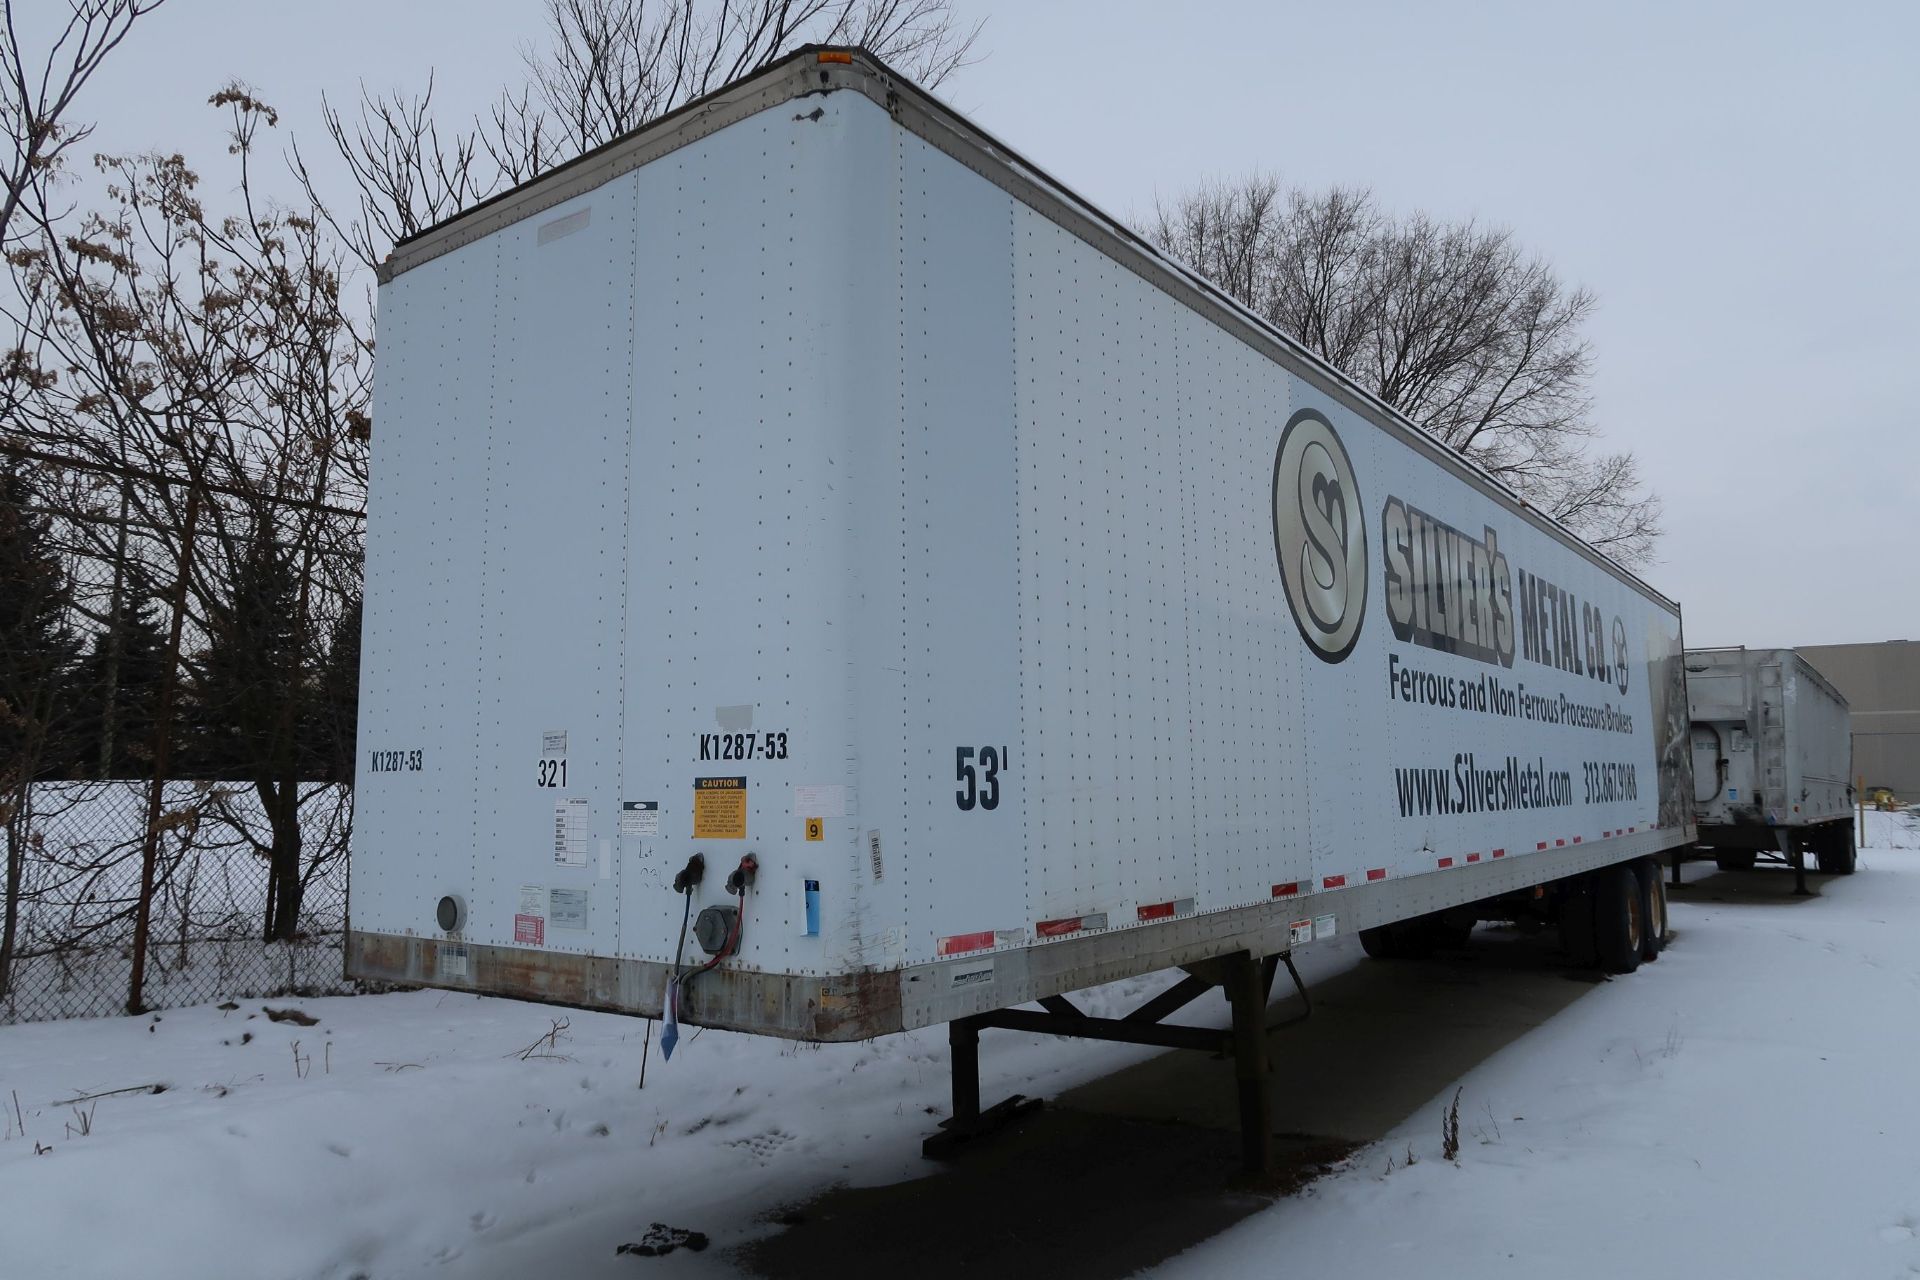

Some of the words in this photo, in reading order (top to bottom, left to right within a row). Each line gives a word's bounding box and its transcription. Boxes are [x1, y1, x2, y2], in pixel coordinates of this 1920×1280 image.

[1381, 494, 1515, 669] SILVER'S
[1518, 567, 1583, 676] METAL
[1583, 600, 1612, 684] CO.
[1388, 653, 1456, 709] Ferrous
[1459, 671, 1487, 713] and
[1488, 676, 1516, 717] Non
[1517, 683, 1559, 725] Ferrous
[1559, 693, 1633, 735] Processors/Brokers
[371, 749, 423, 772] K1287-53
[700, 732, 788, 761] K1287-53
[537, 759, 567, 788] 321
[702, 779, 739, 788] CAUTION
[1394, 752, 1573, 818] www.SilversMetal.com
[1583, 761, 1638, 805] 313.867.9188
[809, 824, 818, 838] 9
